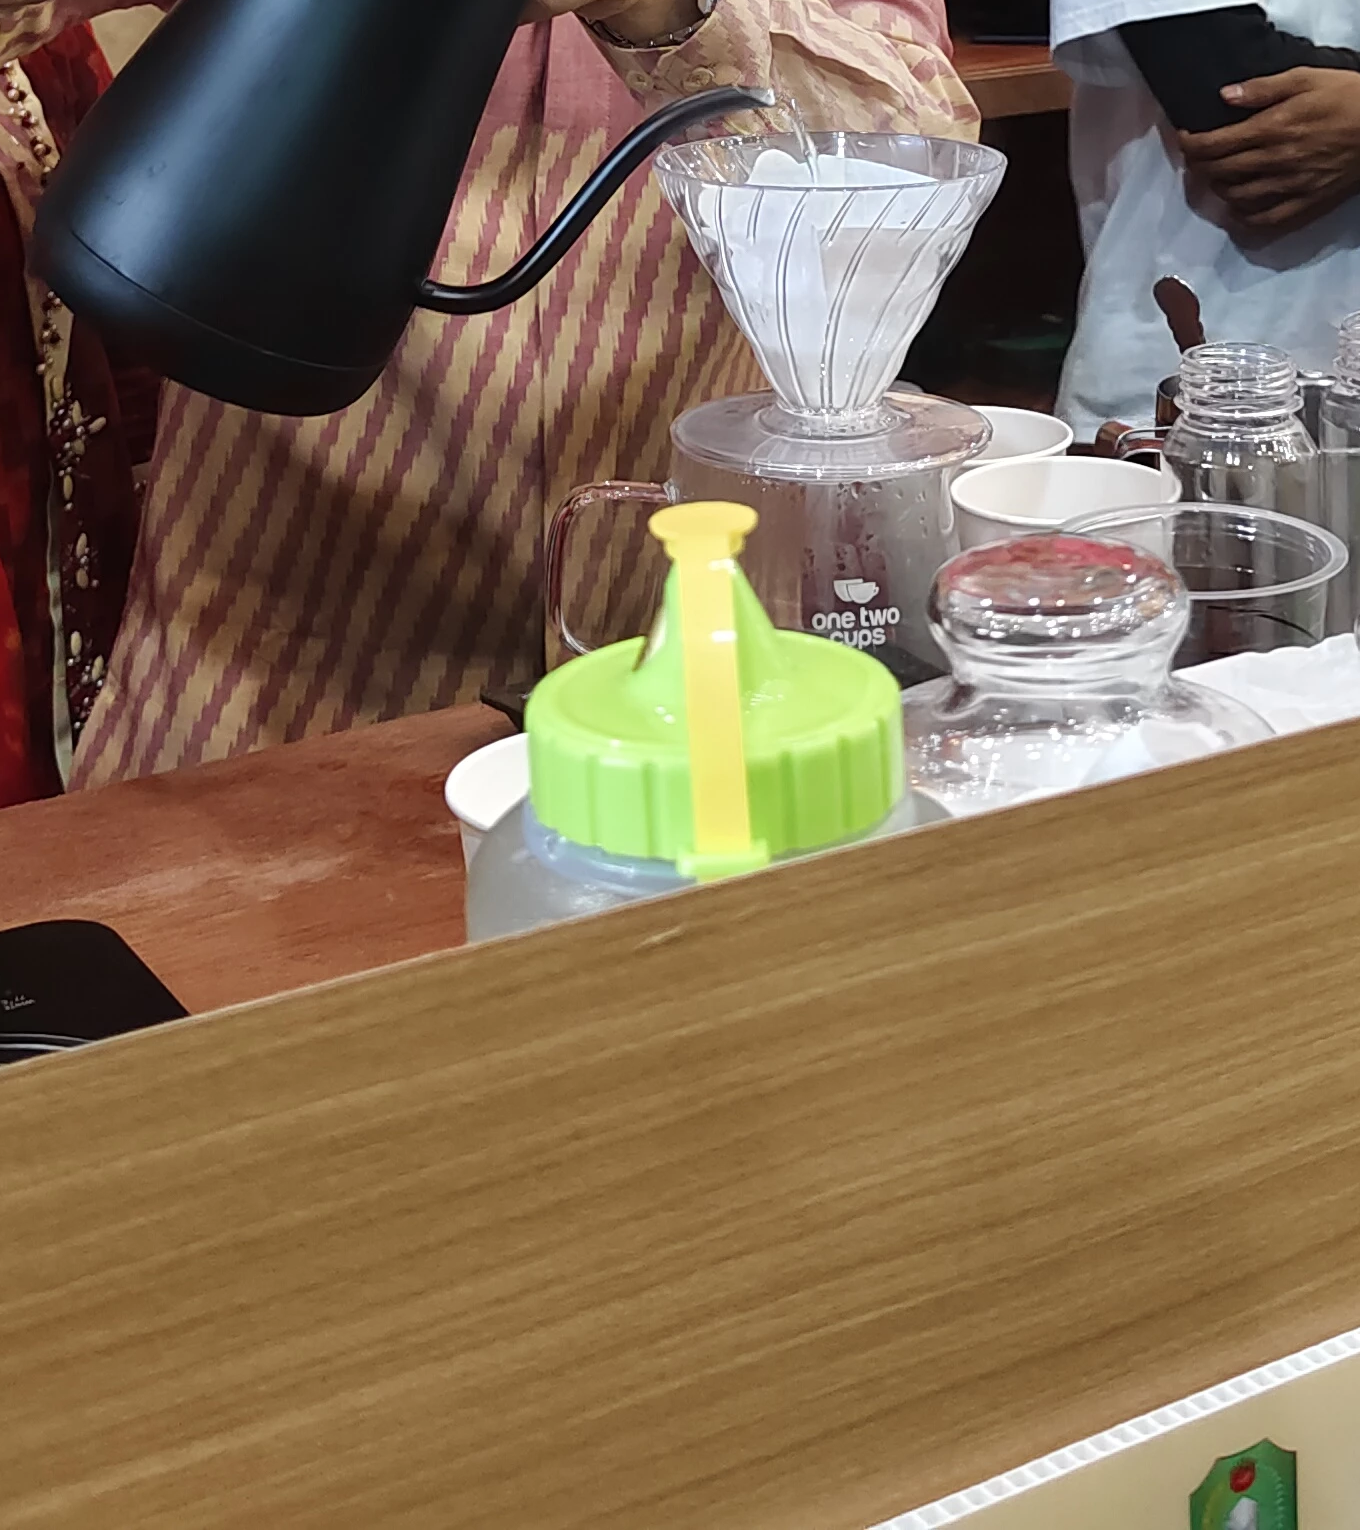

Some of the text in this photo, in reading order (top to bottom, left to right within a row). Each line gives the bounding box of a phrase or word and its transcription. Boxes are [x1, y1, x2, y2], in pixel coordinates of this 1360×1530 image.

[811, 606, 900, 631] one two
[830, 626, 887, 649] cups
